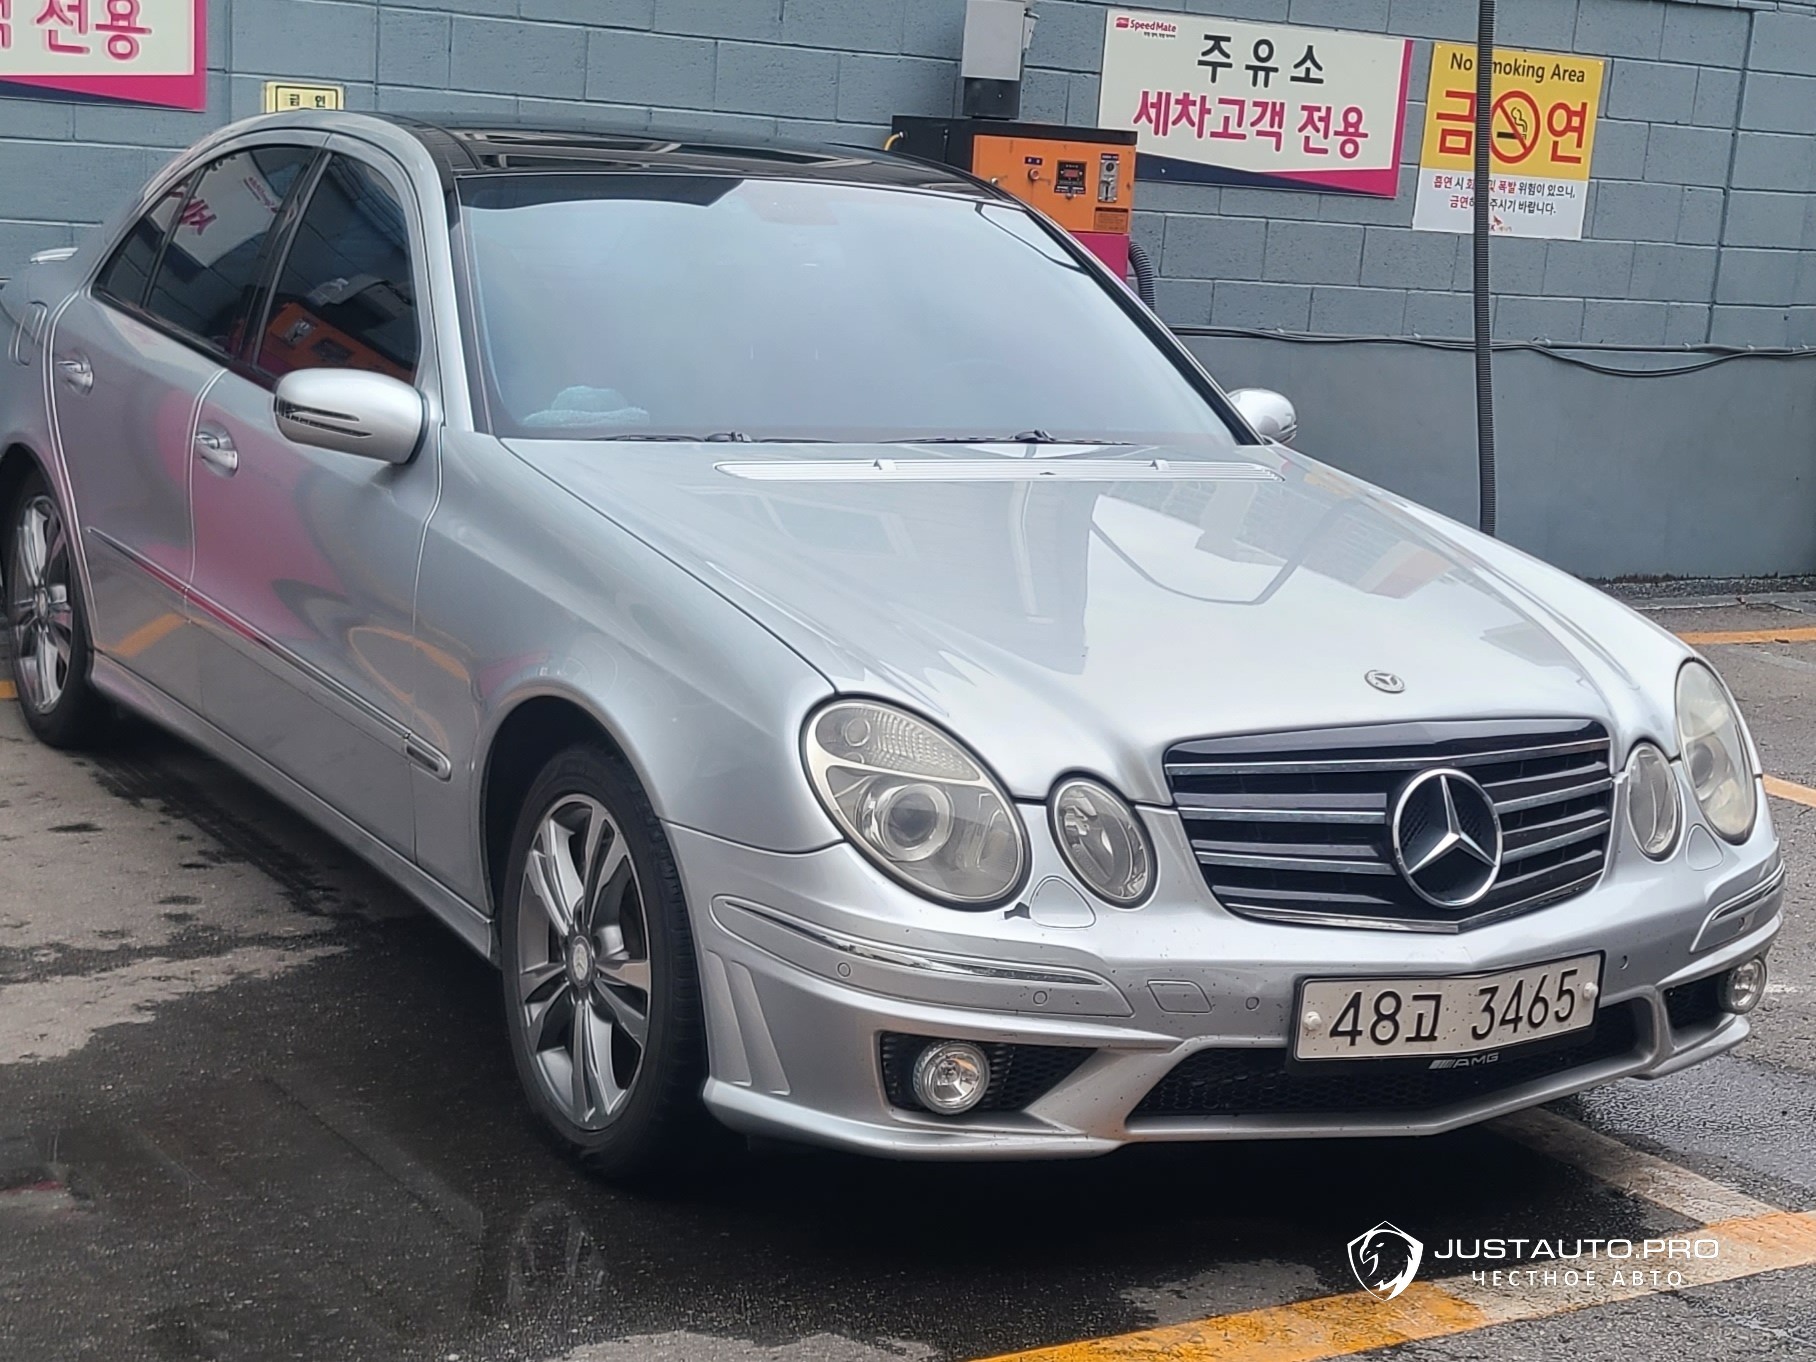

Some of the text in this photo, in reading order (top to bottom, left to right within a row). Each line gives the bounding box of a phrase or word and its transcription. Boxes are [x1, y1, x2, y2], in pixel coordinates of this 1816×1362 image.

[1130, 20, 1177, 32] SpeedMate
[1450, 52, 1585, 83] No moking Area
[1133, 91, 1369, 159] 세차고객 전용
[1547, 102, 1588, 164] 연
[1434, 175, 1453, 189] 흡연
[1454, 177, 1465, 190] 시
[1498, 180, 1517, 193] 폭발
[1518, 182, 1545, 196] 위험이
[1547, 185, 1576, 198] 있으니,
[1489, 199, 1516, 213] 주시기
[1518, 201, 1557, 215] 바랍니다.
[1329, 968, 1578, 1046] 48고 3465
